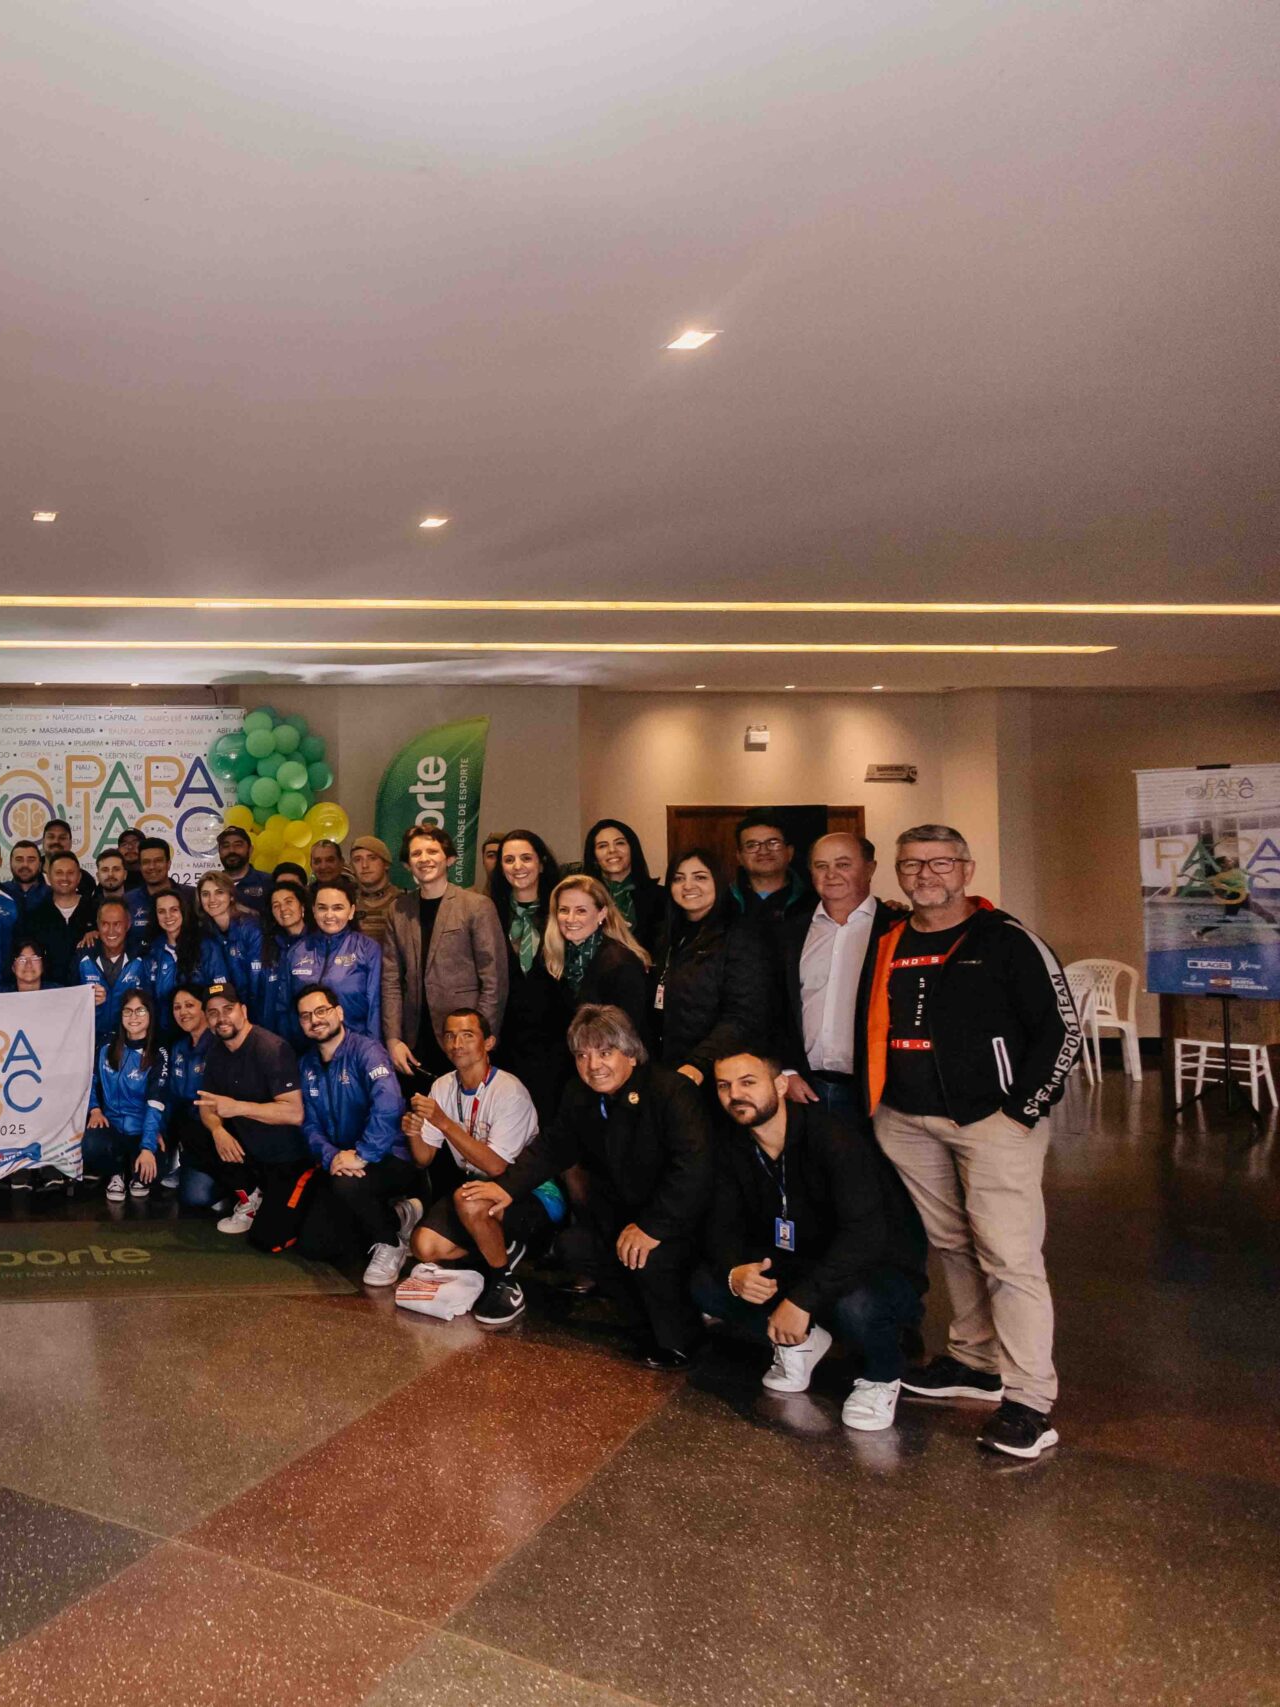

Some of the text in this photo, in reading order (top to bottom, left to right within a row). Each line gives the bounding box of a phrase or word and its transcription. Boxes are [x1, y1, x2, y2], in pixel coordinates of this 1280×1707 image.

[66, 754, 224, 813] PARA
[459, 757, 469, 801] ESPORTE
[458, 802, 467, 816] DE
[1052, 973, 1074, 1017] TEAM
[1059, 1022, 1082, 1068] SPORT
[368, 1066, 390, 1080] VIVA
